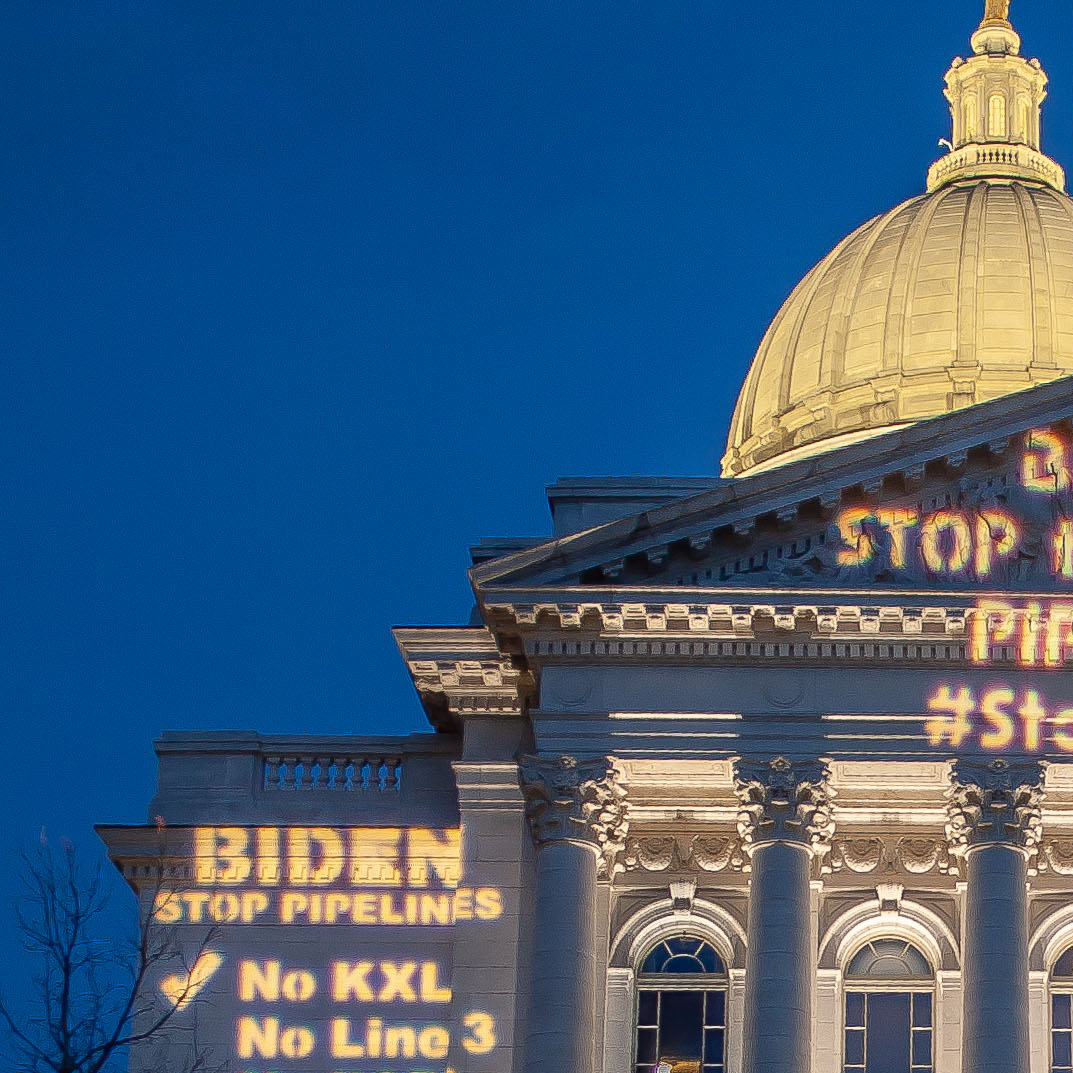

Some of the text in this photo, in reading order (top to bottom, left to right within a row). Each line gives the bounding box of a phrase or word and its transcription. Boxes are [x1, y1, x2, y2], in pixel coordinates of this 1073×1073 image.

[835, 506, 1022, 579] STOP
[193, 826, 466, 888] BIDEN
[153, 887, 504, 925] STOP PIPELINES
[237, 959, 453, 1003] No KXL
[236, 1011, 498, 1060] No Line 3
